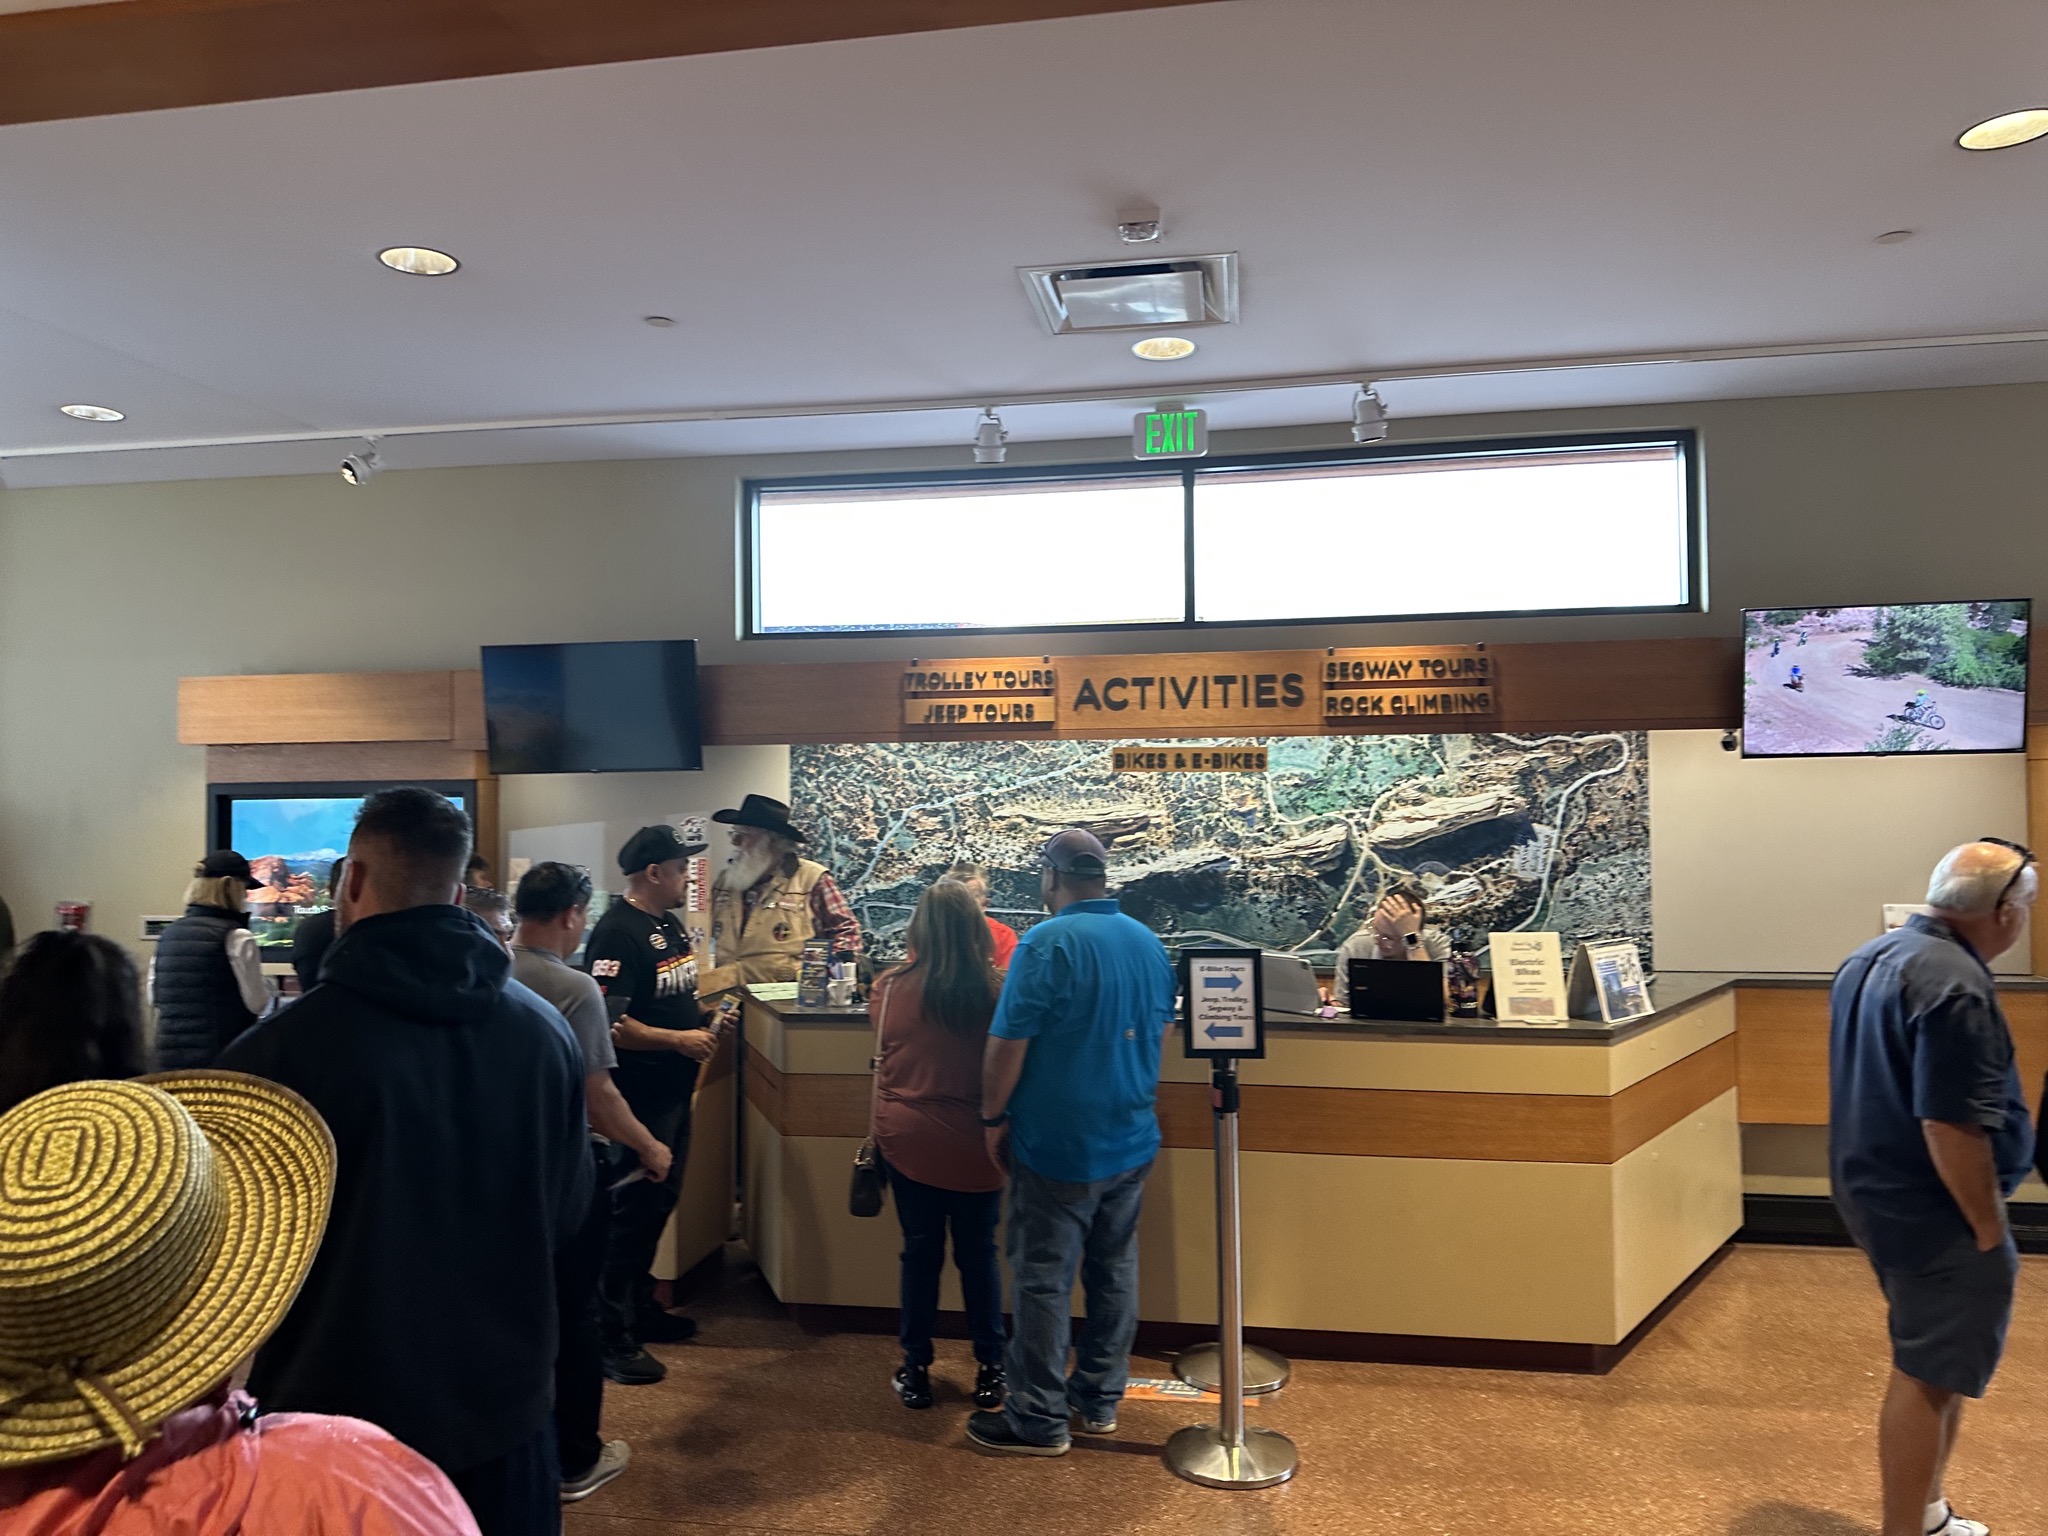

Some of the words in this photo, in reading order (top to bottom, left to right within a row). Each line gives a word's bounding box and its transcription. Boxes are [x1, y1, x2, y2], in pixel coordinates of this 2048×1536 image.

[1145, 411, 1198, 454] EXIT
[904, 670, 988, 690] TROLLEY
[993, 669, 1054, 689] TOURS
[1326, 659, 1414, 681] SEGWAY
[1418, 657, 1489, 678] TOURS
[1072, 673, 1305, 712] ACTIVITIES
[1326, 695, 1384, 716] ROCK
[1390, 692, 1490, 716] CLIMBING
[923, 703, 968, 722] JEEP
[973, 703, 1035, 722] TOURS
[1114, 752, 1168, 769] BIKES
[1174, 752, 1187, 769] &
[1192, 752, 1266, 769] E-BIKES
